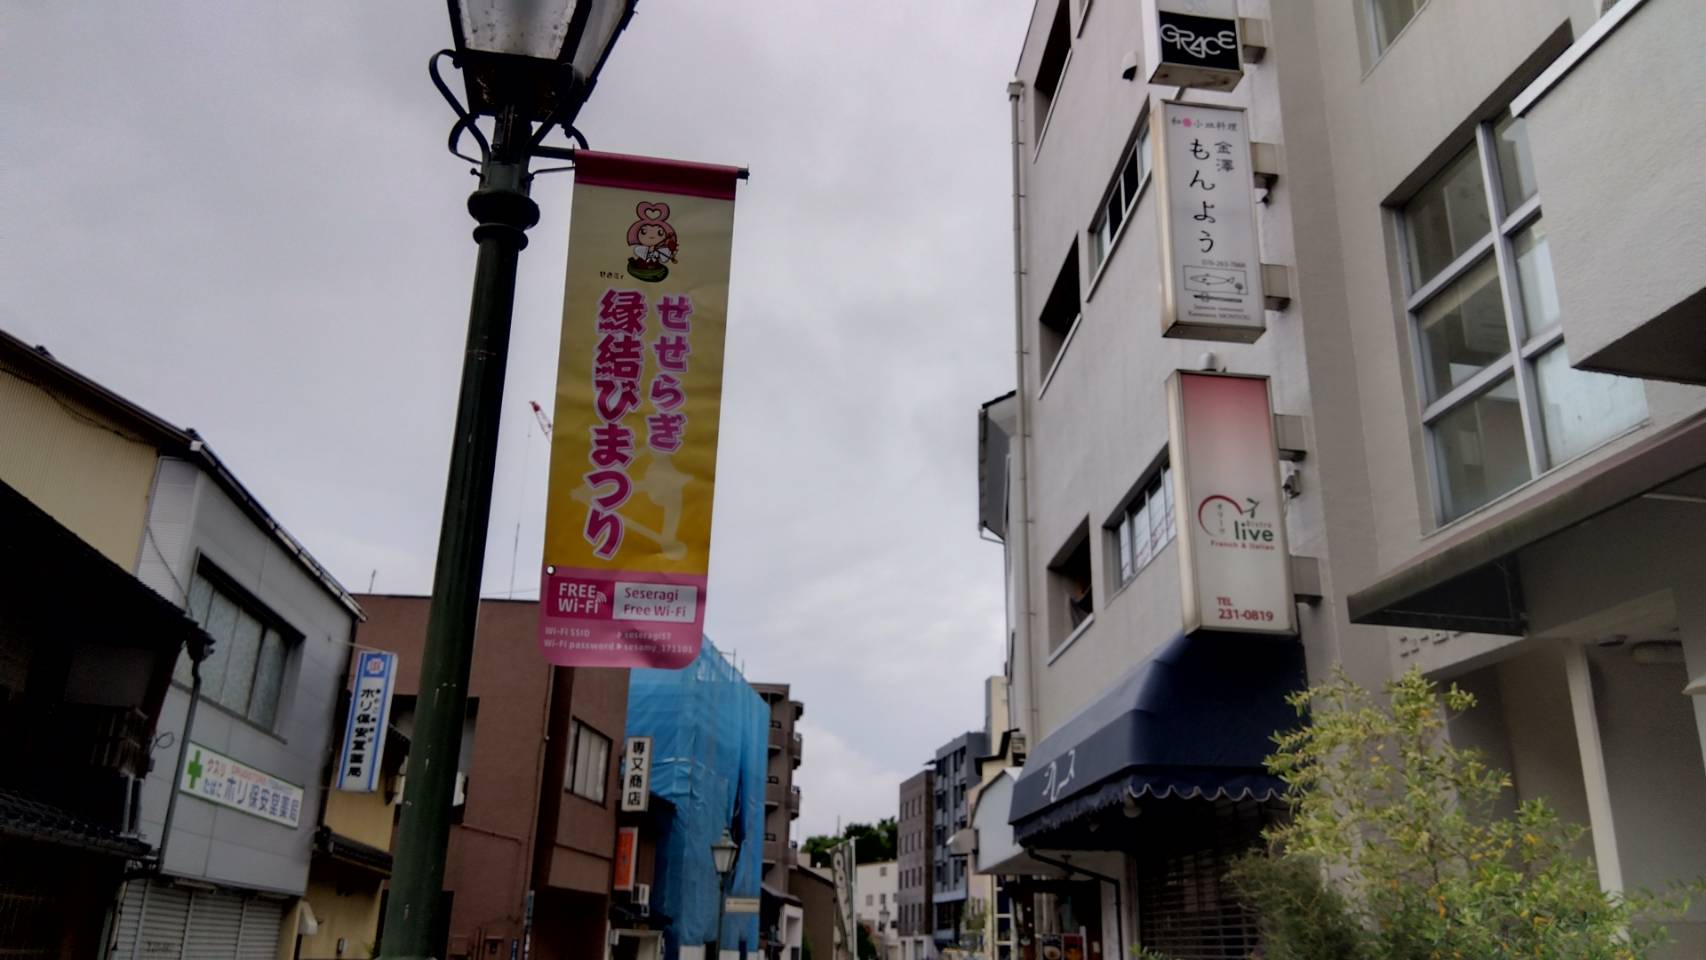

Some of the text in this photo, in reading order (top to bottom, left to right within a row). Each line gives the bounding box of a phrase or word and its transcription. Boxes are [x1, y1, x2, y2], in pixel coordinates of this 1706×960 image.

[1161, 23, 1236, 58] GRACE
[1188, 138, 1216, 253] もんよう
[649, 296, 691, 451] せせらぎ
[584, 289, 646, 559] 縁結びまつり
[559, 583, 597, 599] FREE
[624, 587, 679, 603] Seseragi
[558, 598, 599, 614] Wi-Fi
[1217, 597, 1233, 606] TEL
[623, 605, 687, 617] Free Wi-Fi
[1218, 608, 1274, 621] 231-0819
[545, 626, 569, 636] Wi-Fi
[570, 627, 591, 637] SSID
[544, 639, 568, 648] Wi-Fi
[569, 640, 616, 651] password
